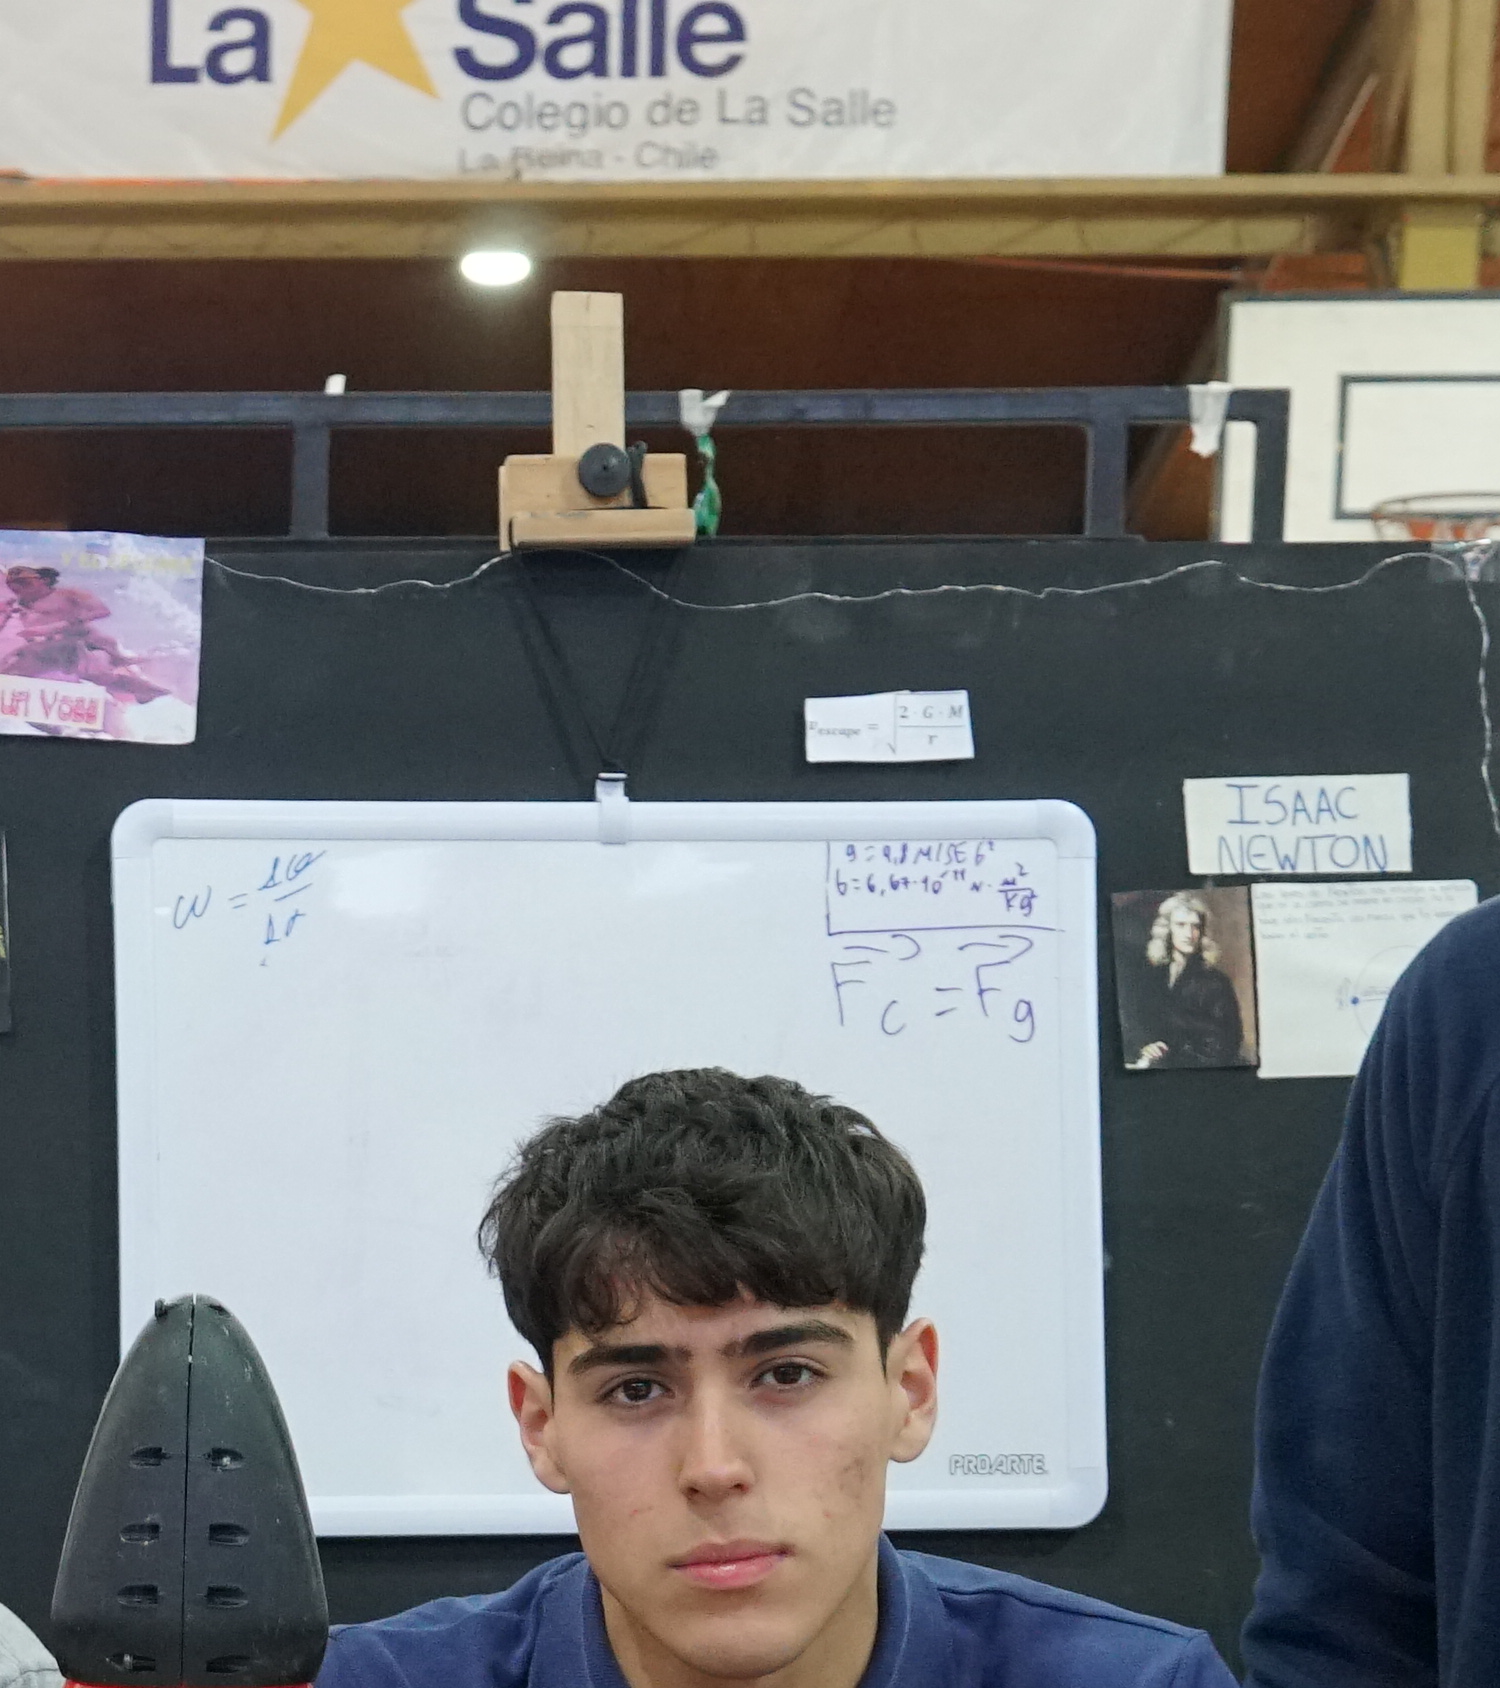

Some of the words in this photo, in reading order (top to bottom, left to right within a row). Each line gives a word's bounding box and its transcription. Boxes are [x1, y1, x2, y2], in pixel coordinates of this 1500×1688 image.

[150, 0, 274, 84] La
[452, 0, 748, 83] Salle
[461, 91, 630, 139] Colegio
[647, 90, 701, 127] de
[716, 89, 769, 126] La
[786, 87, 897, 129] Salle
[632, 141, 720, 169] Chile
[1225, 782, 1359, 827] ISAAC
[1216, 833, 1389, 874] NEWTON
[948, 1453, 1047, 1476] PROARTE
